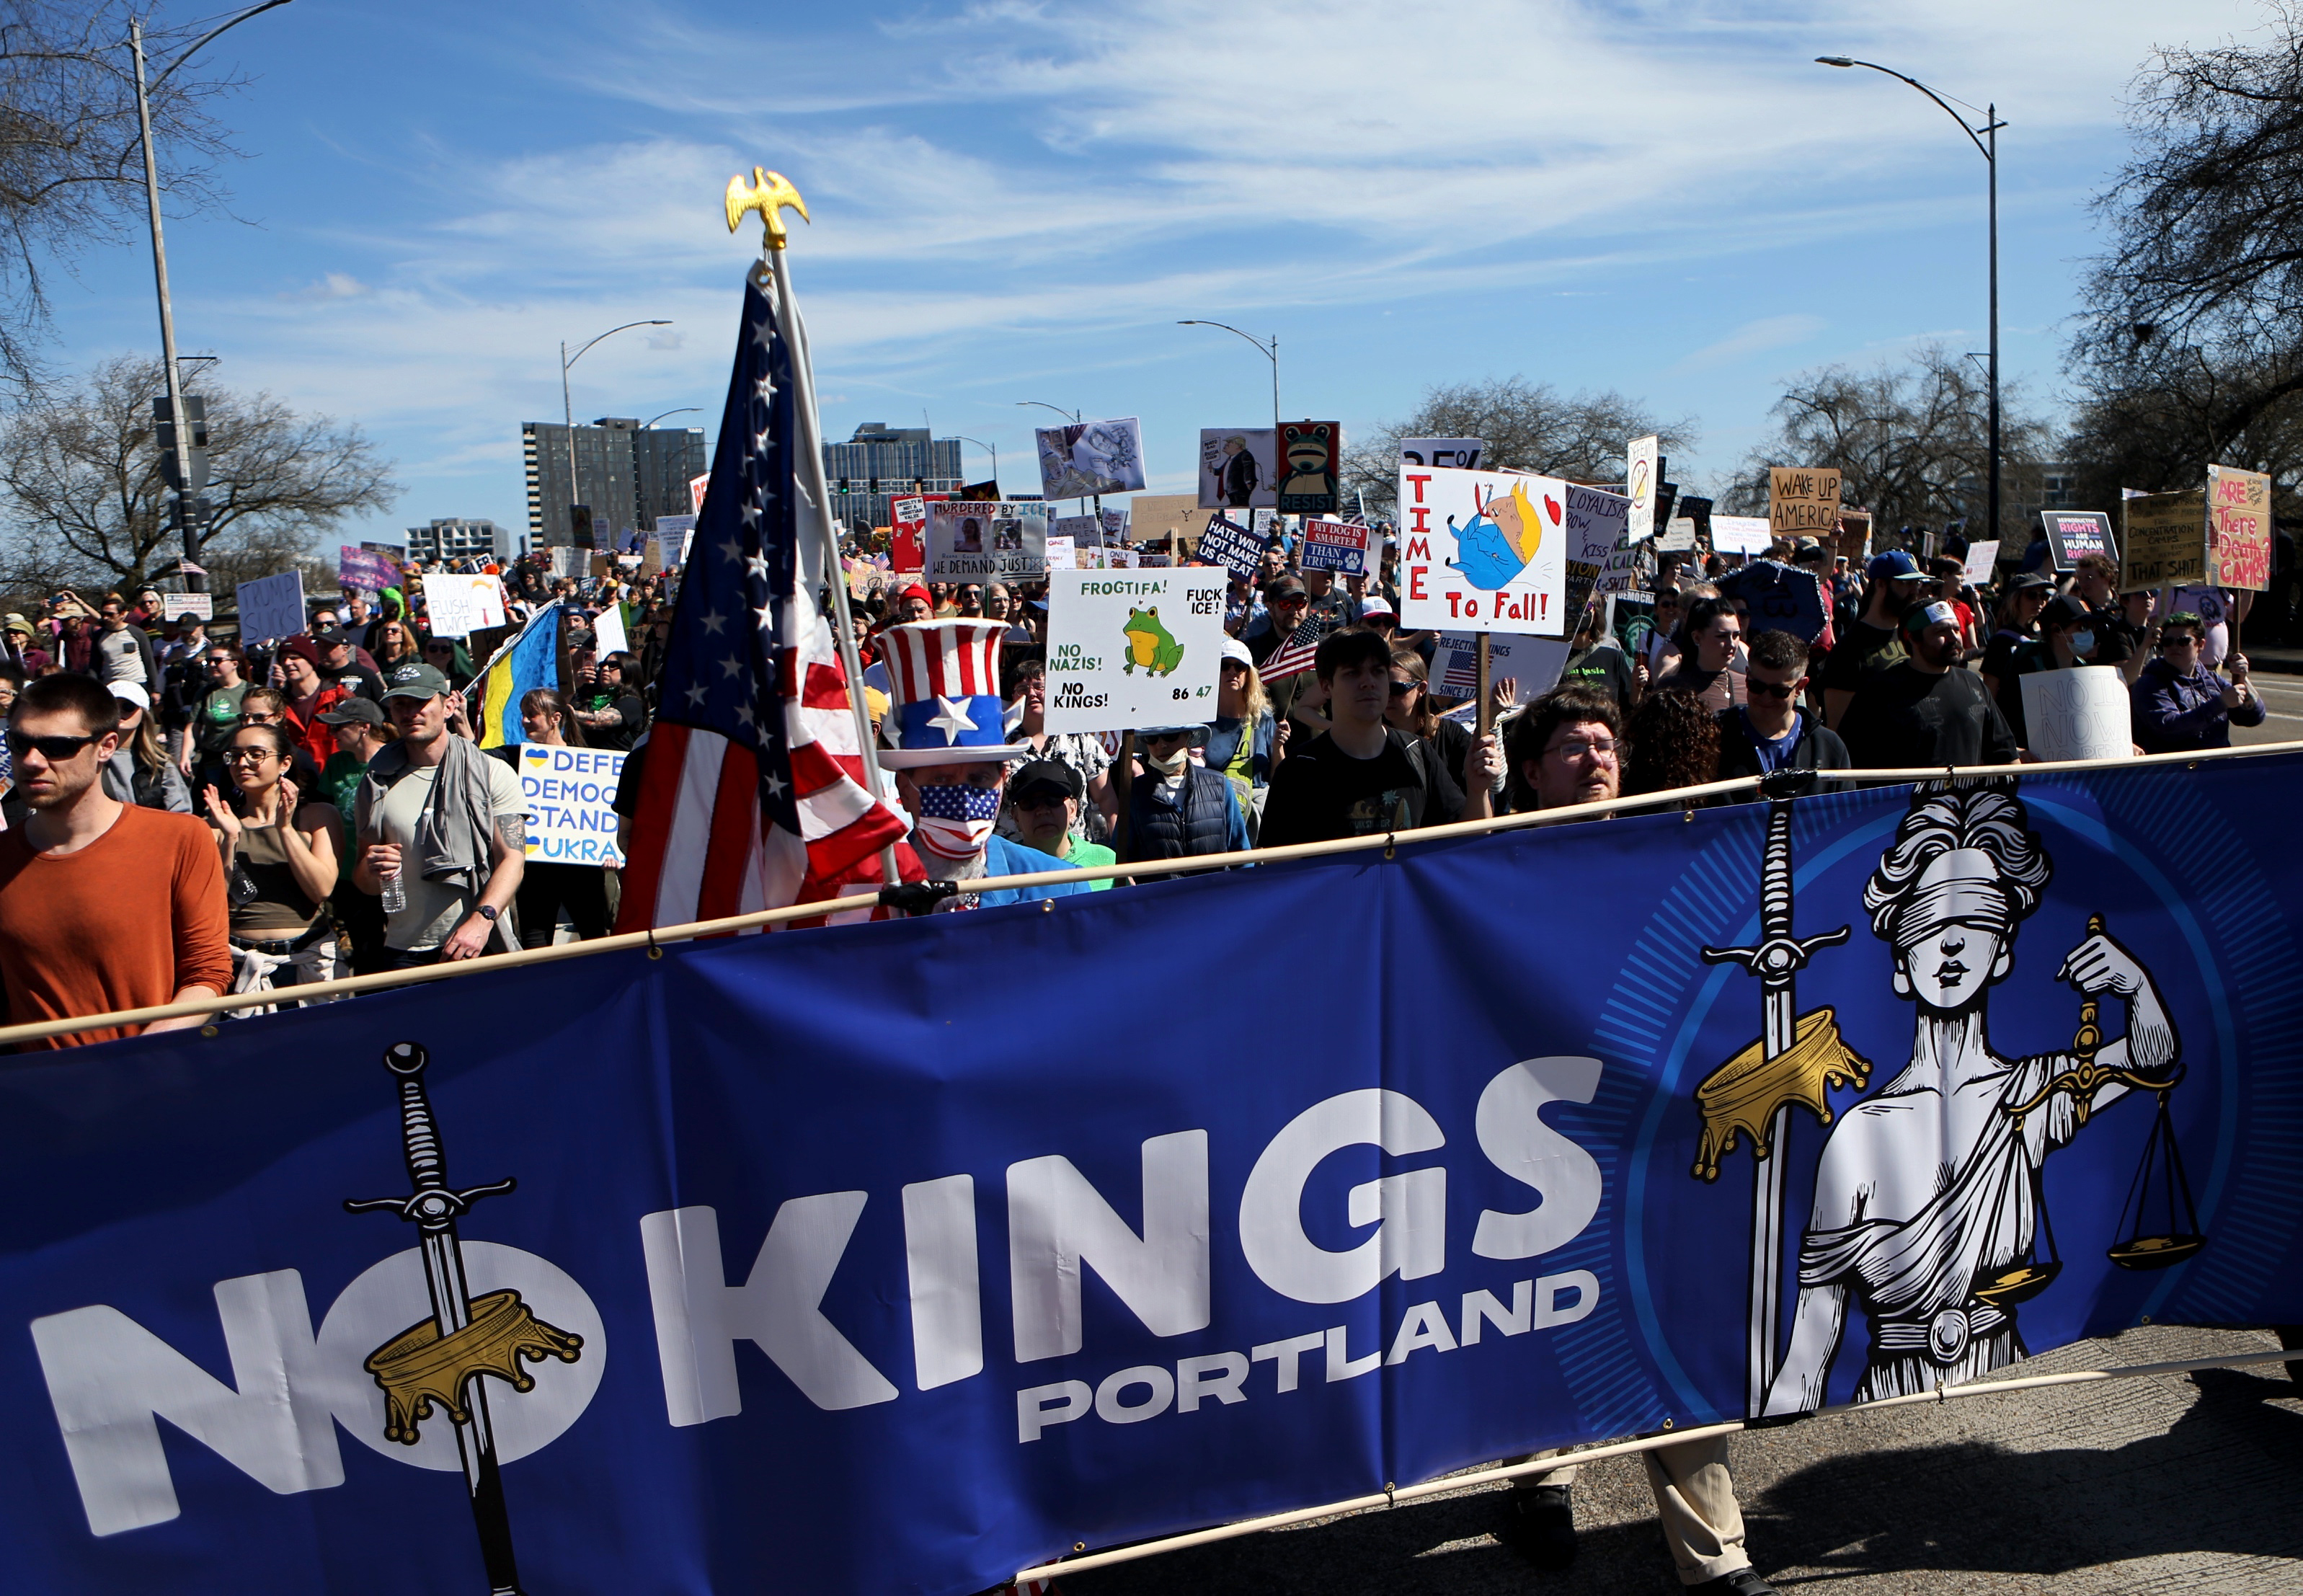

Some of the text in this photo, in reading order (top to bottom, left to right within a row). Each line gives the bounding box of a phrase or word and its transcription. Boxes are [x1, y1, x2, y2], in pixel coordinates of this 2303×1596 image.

[1629, 440, 1654, 465] DEFEND
[1775, 473, 1837, 497] WAKE UP
[2217, 479, 2247, 505] ARE
[934, 502, 1046, 516] MURDERED BY ICE
[1281, 495, 1334, 510] RESIST
[1566, 487, 1629, 520] LOYALISTS
[2059, 523, 2100, 533] RIGHTS
[2217, 505, 2258, 536] There
[1208, 520, 1261, 555] HATE WILL
[1313, 522, 1362, 538] MY DOG IS
[1405, 474, 1432, 600] TIME
[2129, 523, 2195, 538] CONCENTRATION
[1315, 533, 1358, 548] SMARTER
[2062, 539, 2104, 549] HUMAN
[2148, 535, 2180, 545] CAMPS
[1110, 551, 1130, 559] ONLY
[1203, 532, 1259, 566] NOT MAKE
[1310, 544, 1341, 559] THAN
[1581, 543, 1609, 559] KISS
[933, 560, 946, 575] WE
[949, 558, 995, 575] DEMAND
[1199, 546, 1255, 577] US GREAT
[2128, 560, 2164, 580] THAT
[427, 575, 470, 588] SOMETIMES
[1080, 579, 1168, 595] FROGTIFA!
[1606, 574, 1632, 591] SHIT
[239, 575, 296, 610] TRUMP
[1186, 588, 1223, 602] FUCK
[430, 599, 471, 615] FLUSH
[1445, 591, 1549, 621] To Fall!
[244, 603, 300, 641] SUCKS
[434, 616, 472, 633] TWICE
[1057, 644, 1081, 657] NO
[1049, 657, 1103, 672] NAZIS!
[1061, 682, 1085, 696] NO
[1171, 686, 1212, 701] 86 47
[1439, 684, 1462, 697] SINCE
[2038, 674, 2126, 717] NO IC
[1053, 693, 1109, 709] KINGS!
[2041, 711, 2093, 749] NO
[525, 803, 619, 833] STAND
[543, 836, 626, 864] UKRA
[30, 1055, 1605, 1538] NO KINGS
[1016, 1269, 1601, 1443] PORTLAND
